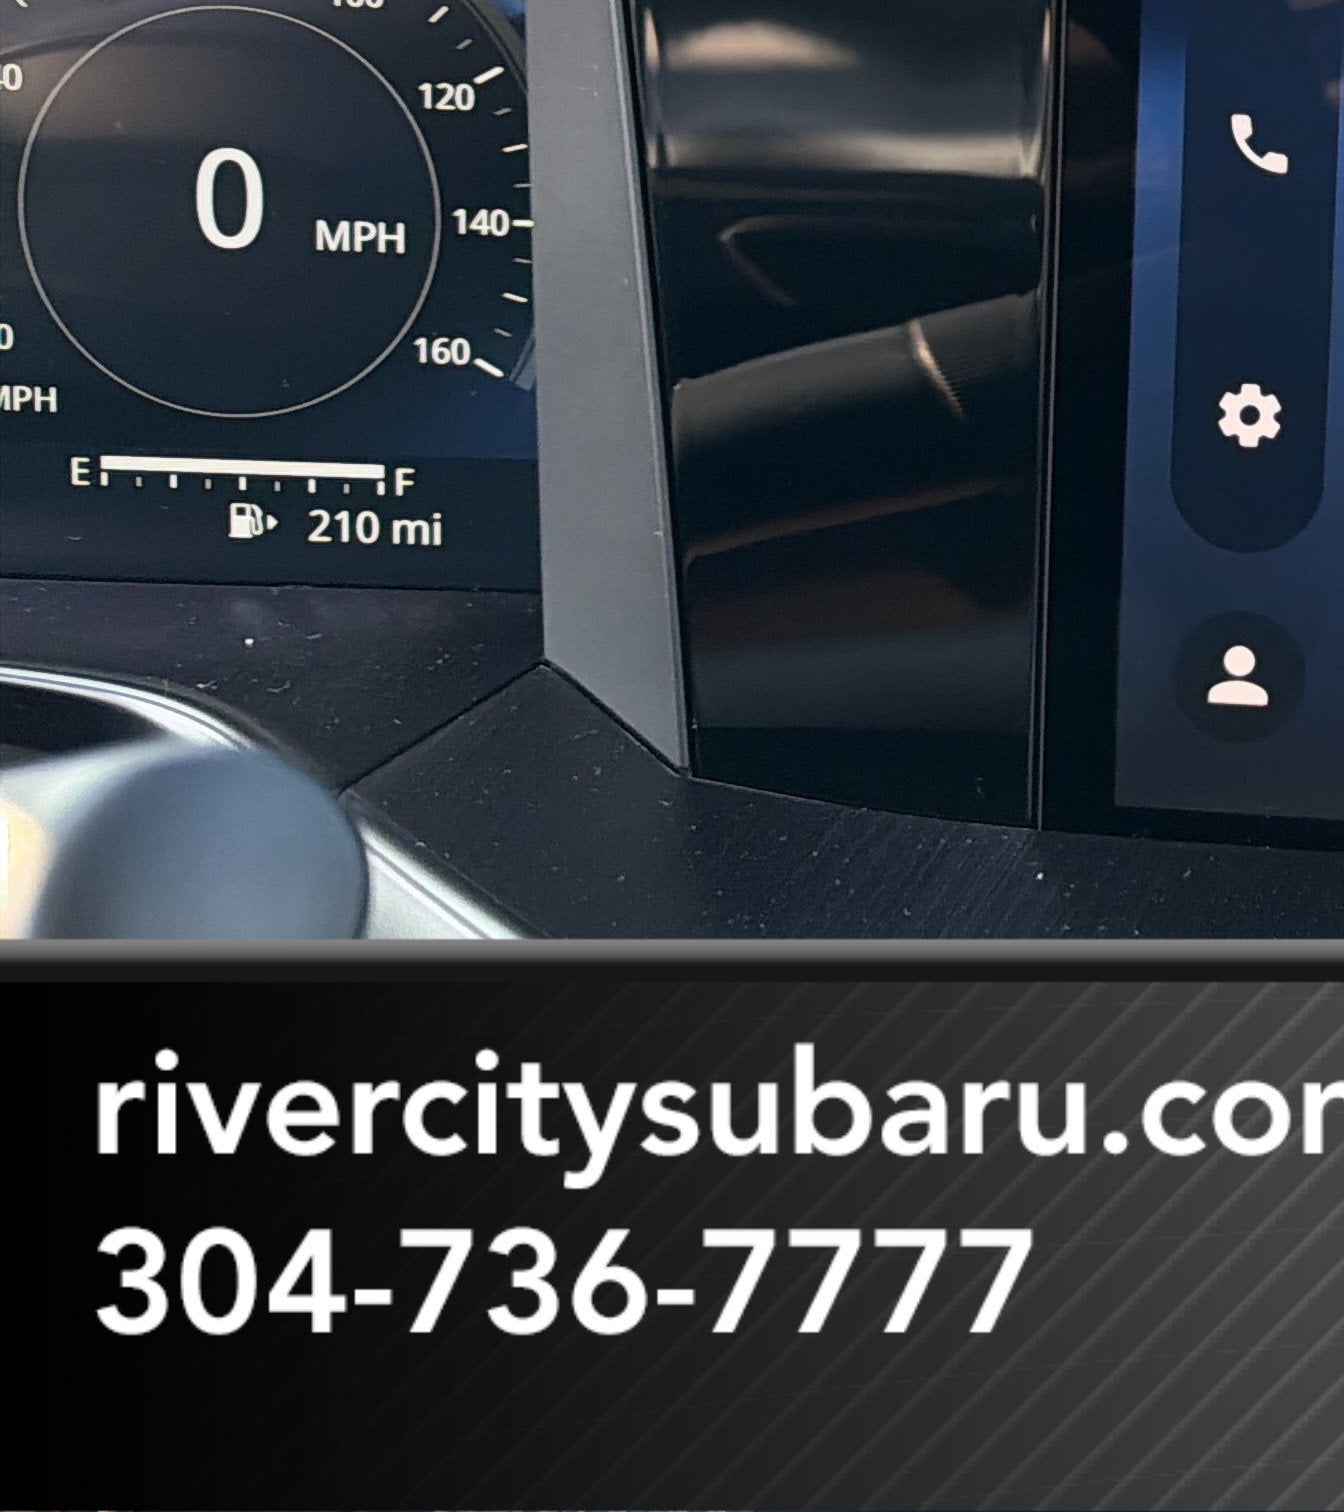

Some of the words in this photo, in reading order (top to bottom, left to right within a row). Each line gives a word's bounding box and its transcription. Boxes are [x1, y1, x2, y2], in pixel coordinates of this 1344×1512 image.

[0, 63, 23, 91] 0
[419, 84, 476, 111] 120
[196, 147, 264, 249] 0
[315, 219, 406, 254] MPH
[452, 208, 510, 237] 140
[413, 337, 471, 366] 160
[70, 456, 91, 486] E
[394, 467, 416, 497] F
[307, 509, 380, 544] 210
[392, 512, 442, 546] mi
